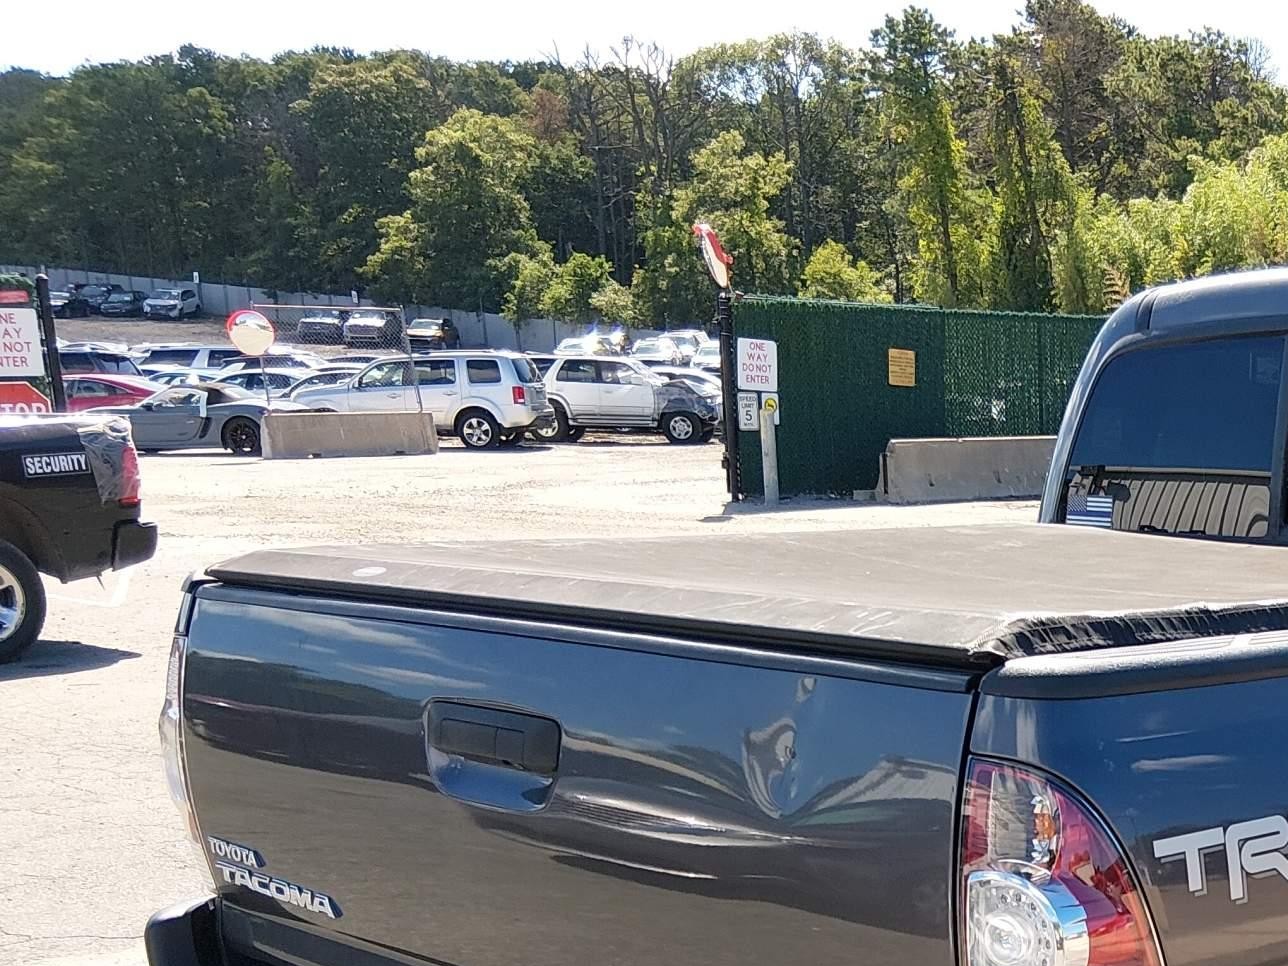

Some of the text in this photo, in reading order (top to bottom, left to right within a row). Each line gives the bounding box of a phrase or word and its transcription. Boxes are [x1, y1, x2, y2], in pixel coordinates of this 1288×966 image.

[0, 313, 16, 324] NE
[2, 328, 22, 338] AY
[3, 341, 32, 352] NOT
[749, 342, 766, 351] ONE
[747, 352, 768, 363] WAY
[742, 363, 772, 373] DO NOT
[746, 375, 769, 384] ENTER
[745, 410, 753, 421] 5
[25, 454, 88, 474] SECURITY
[207, 836, 262, 868] TOYOTA
[215, 860, 341, 919] TACOMA
